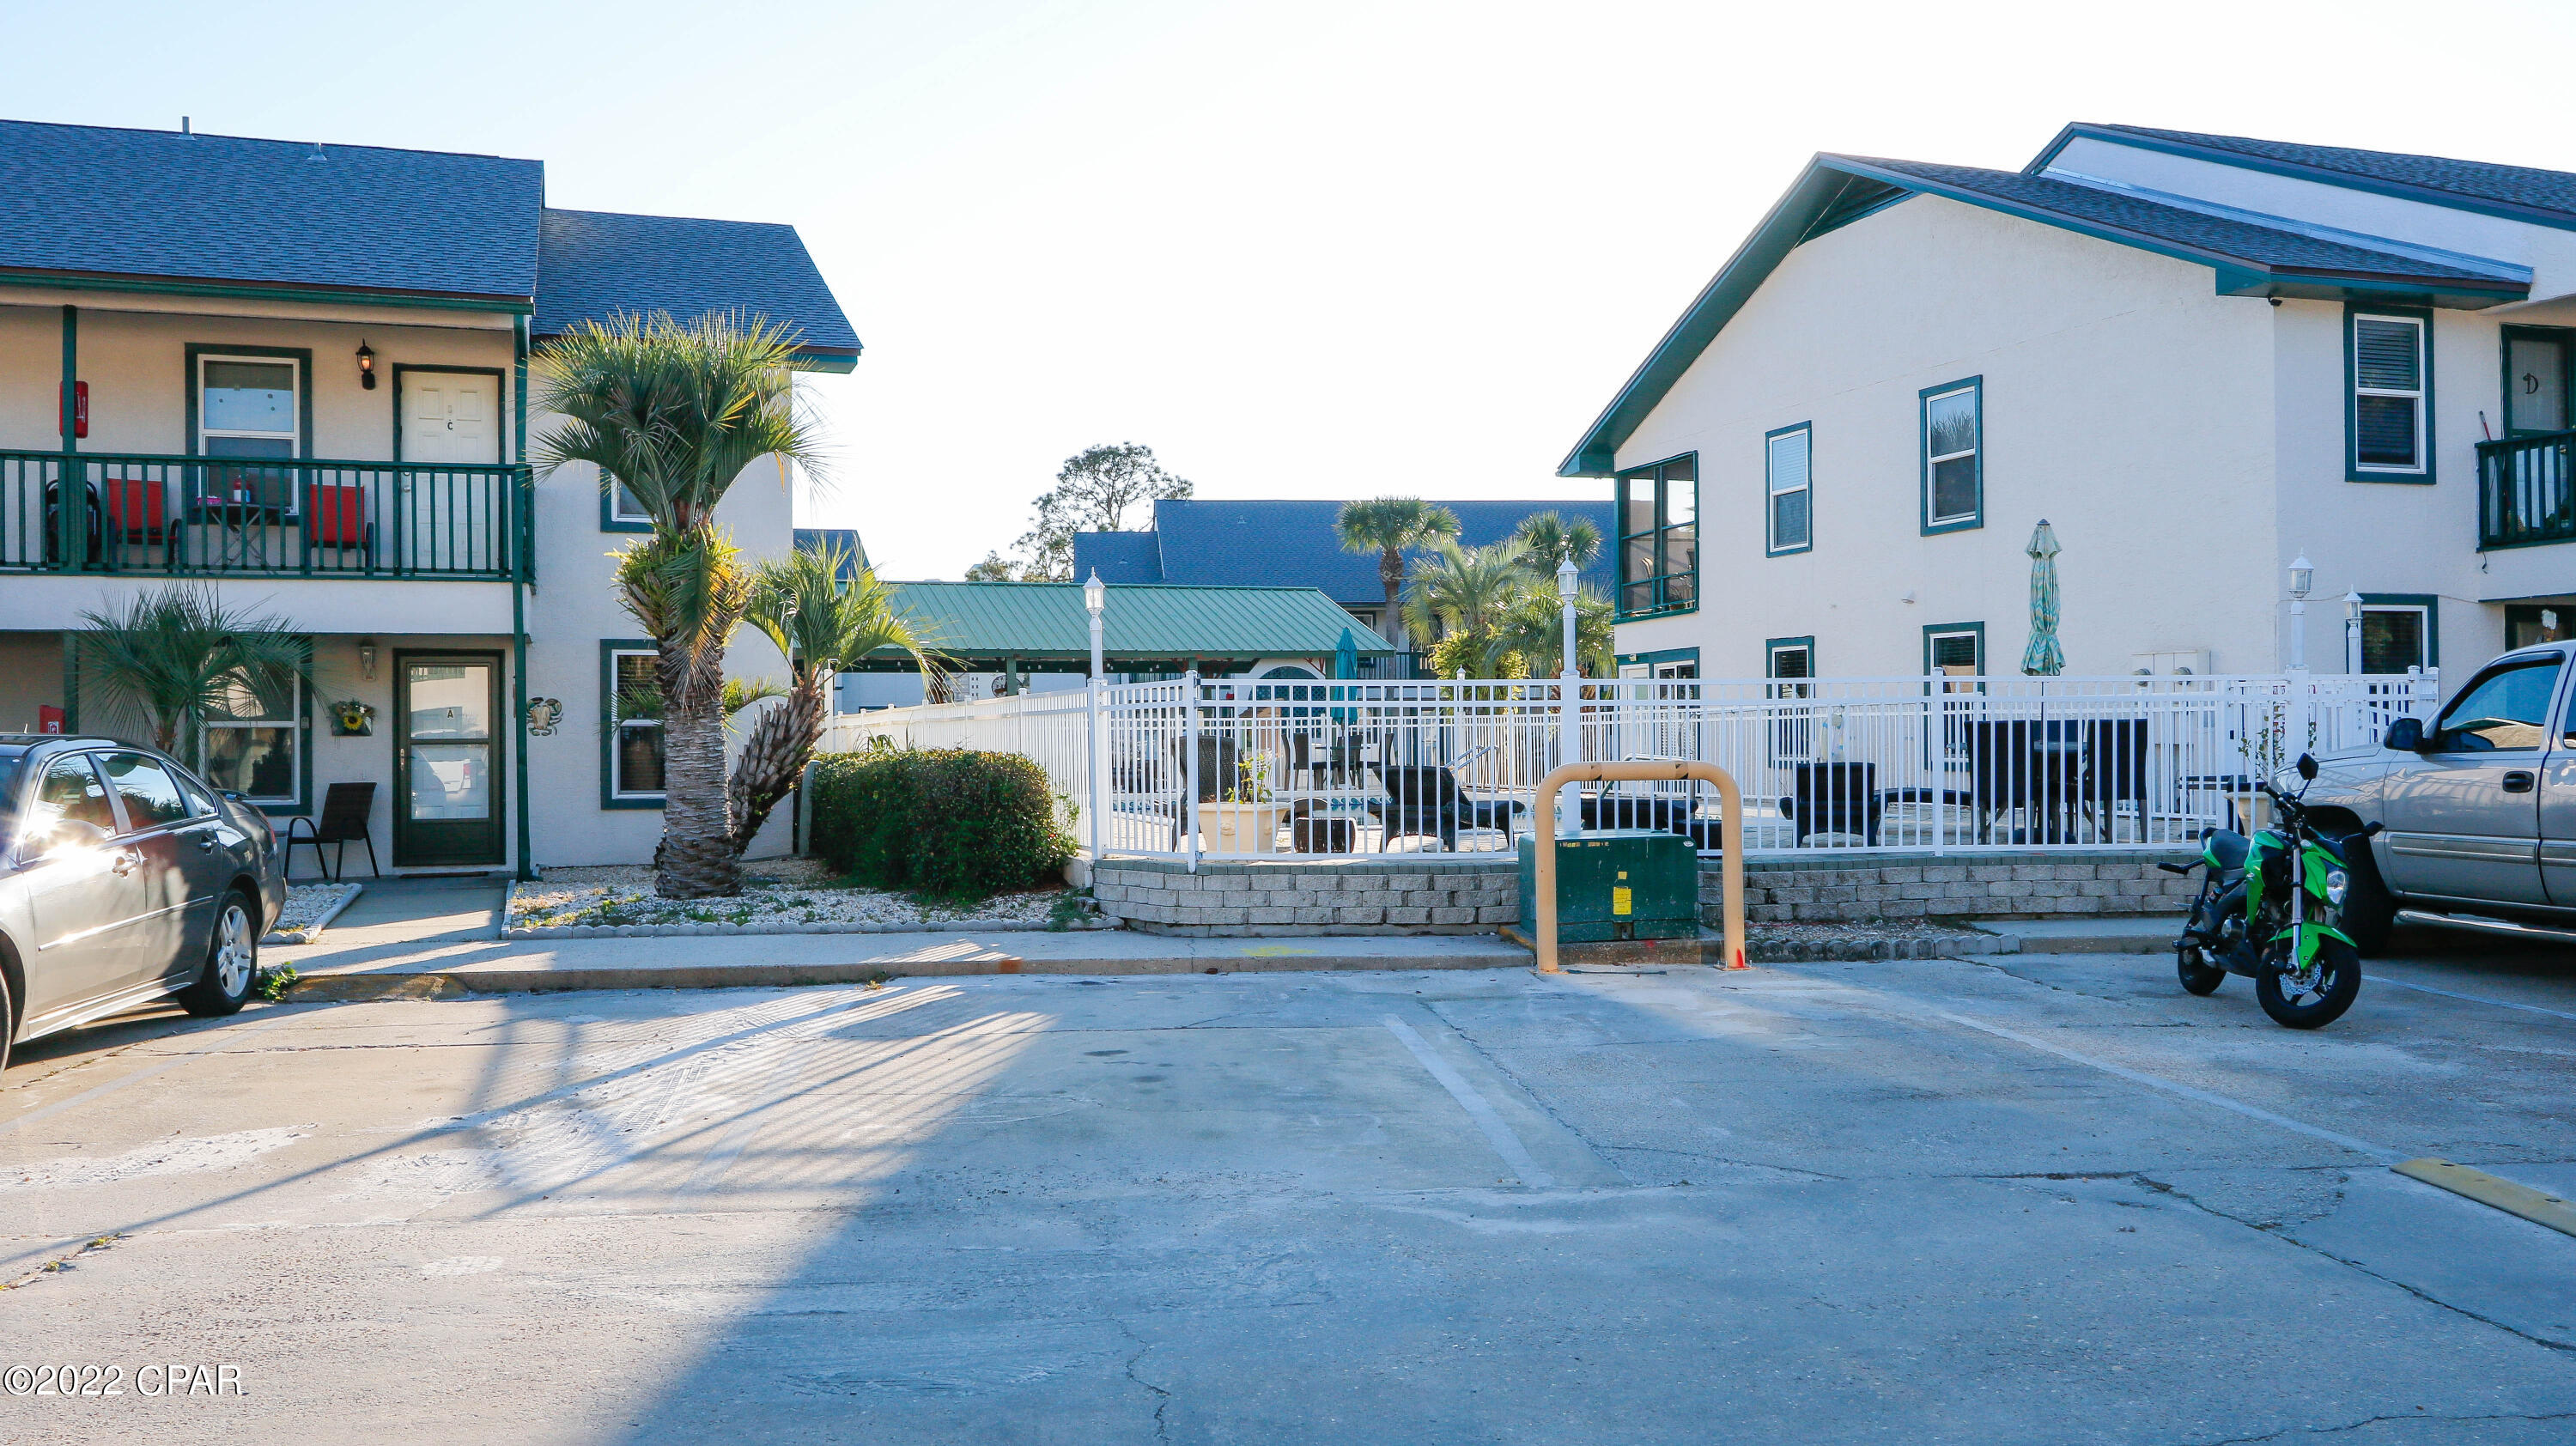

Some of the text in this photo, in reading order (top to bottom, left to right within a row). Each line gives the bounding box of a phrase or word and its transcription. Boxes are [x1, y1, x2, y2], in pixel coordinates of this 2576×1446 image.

[2523, 373, 2539, 394] D
[447, 422, 453, 430] C
[447, 709, 454, 718] A
